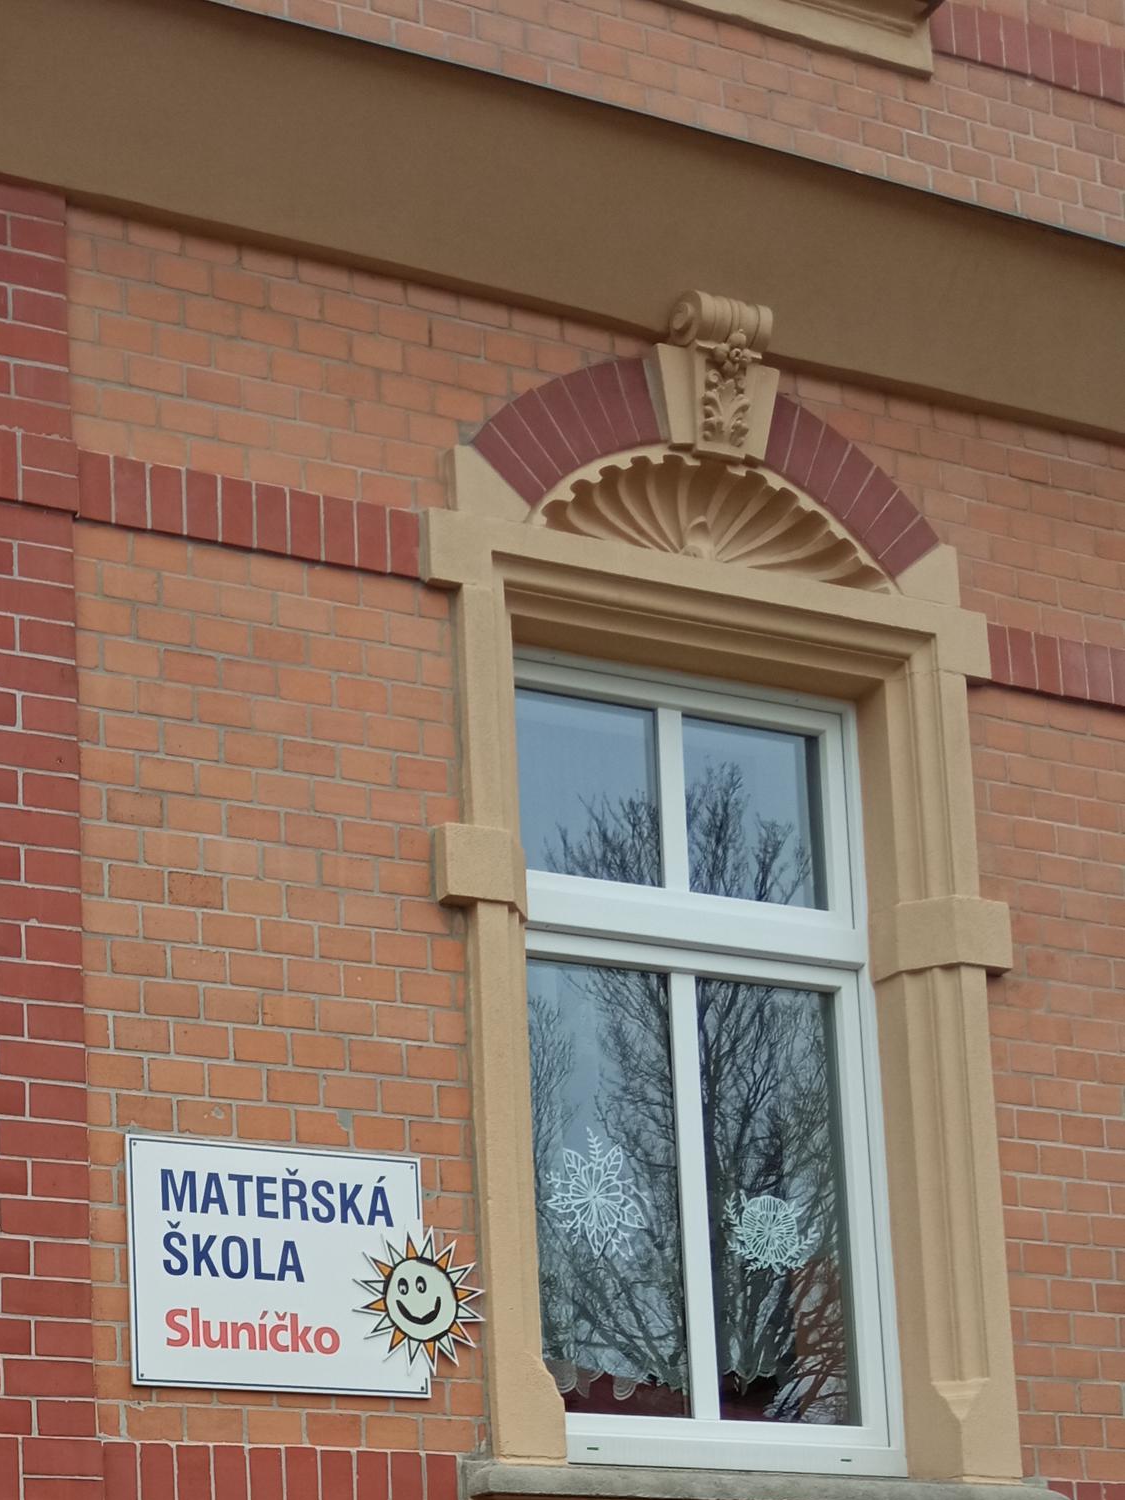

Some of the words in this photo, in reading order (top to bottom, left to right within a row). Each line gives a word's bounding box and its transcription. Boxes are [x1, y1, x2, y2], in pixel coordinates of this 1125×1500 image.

[160, 1168, 394, 1227] MATEŘSKÁ
[162, 1220, 305, 1283] ŠKOLA
[165, 1307, 341, 1355] Sluníčko
